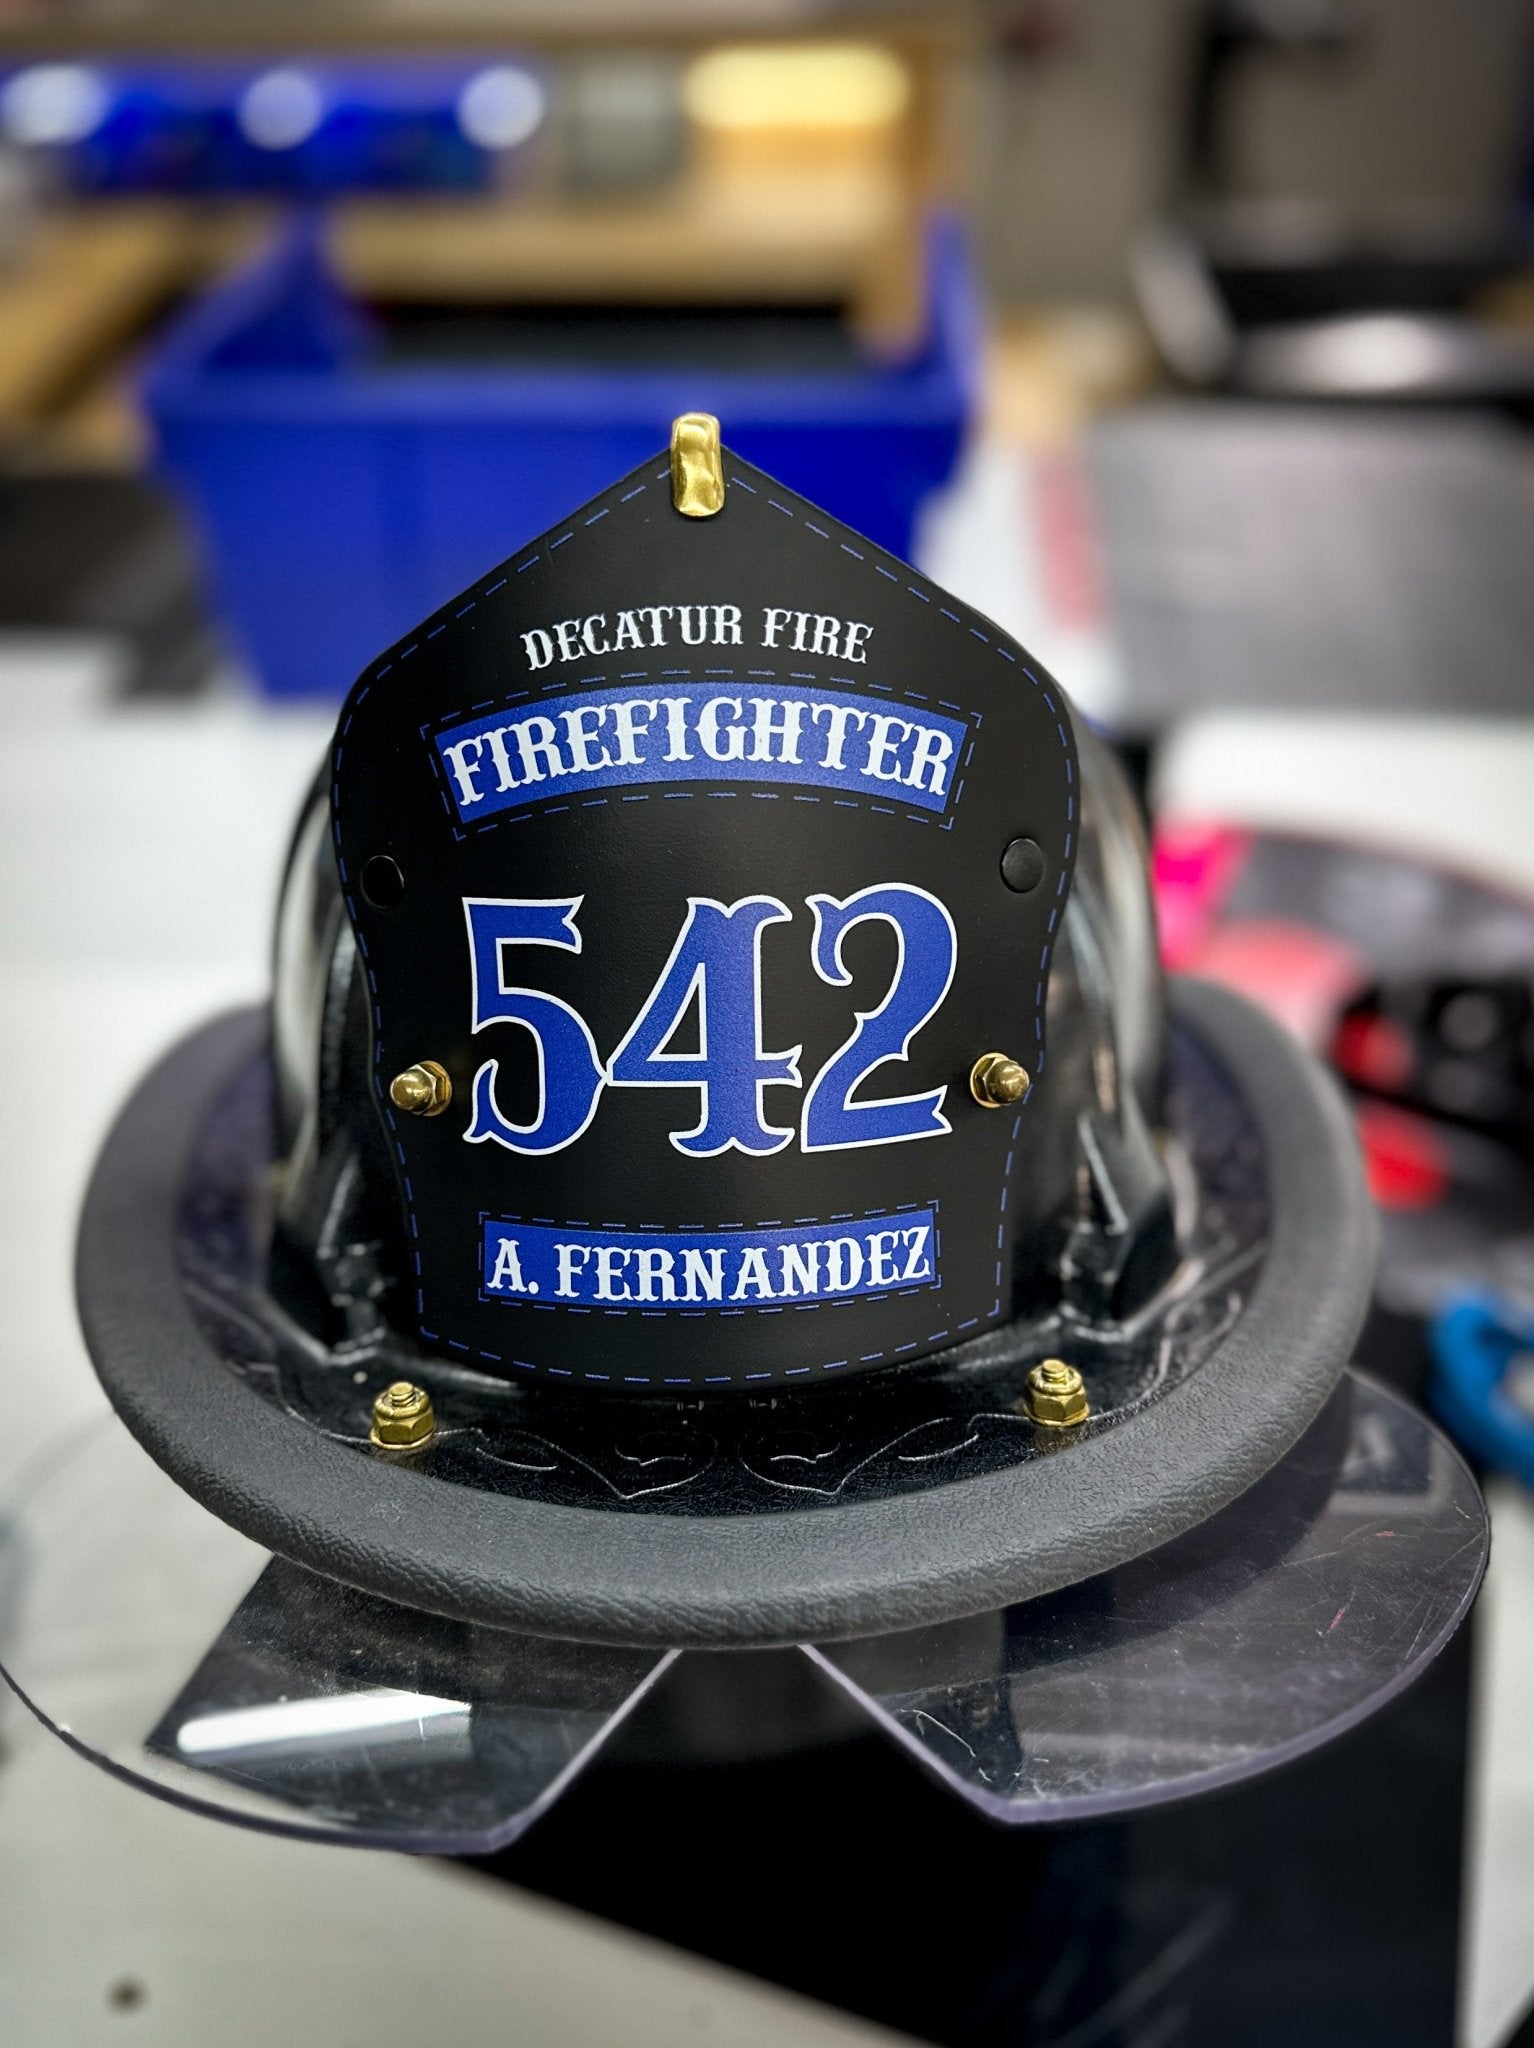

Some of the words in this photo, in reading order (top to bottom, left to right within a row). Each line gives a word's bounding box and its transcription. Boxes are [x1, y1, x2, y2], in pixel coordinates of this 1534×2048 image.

[518, 603, 744, 672] DECATUR
[761, 606, 875, 665] FIRE
[442, 695, 955, 807] FIREFIGHTER
[461, 882, 959, 1159] 542
[487, 1237, 540, 1295] A.
[553, 1224, 932, 1303] FERNANDEZ
